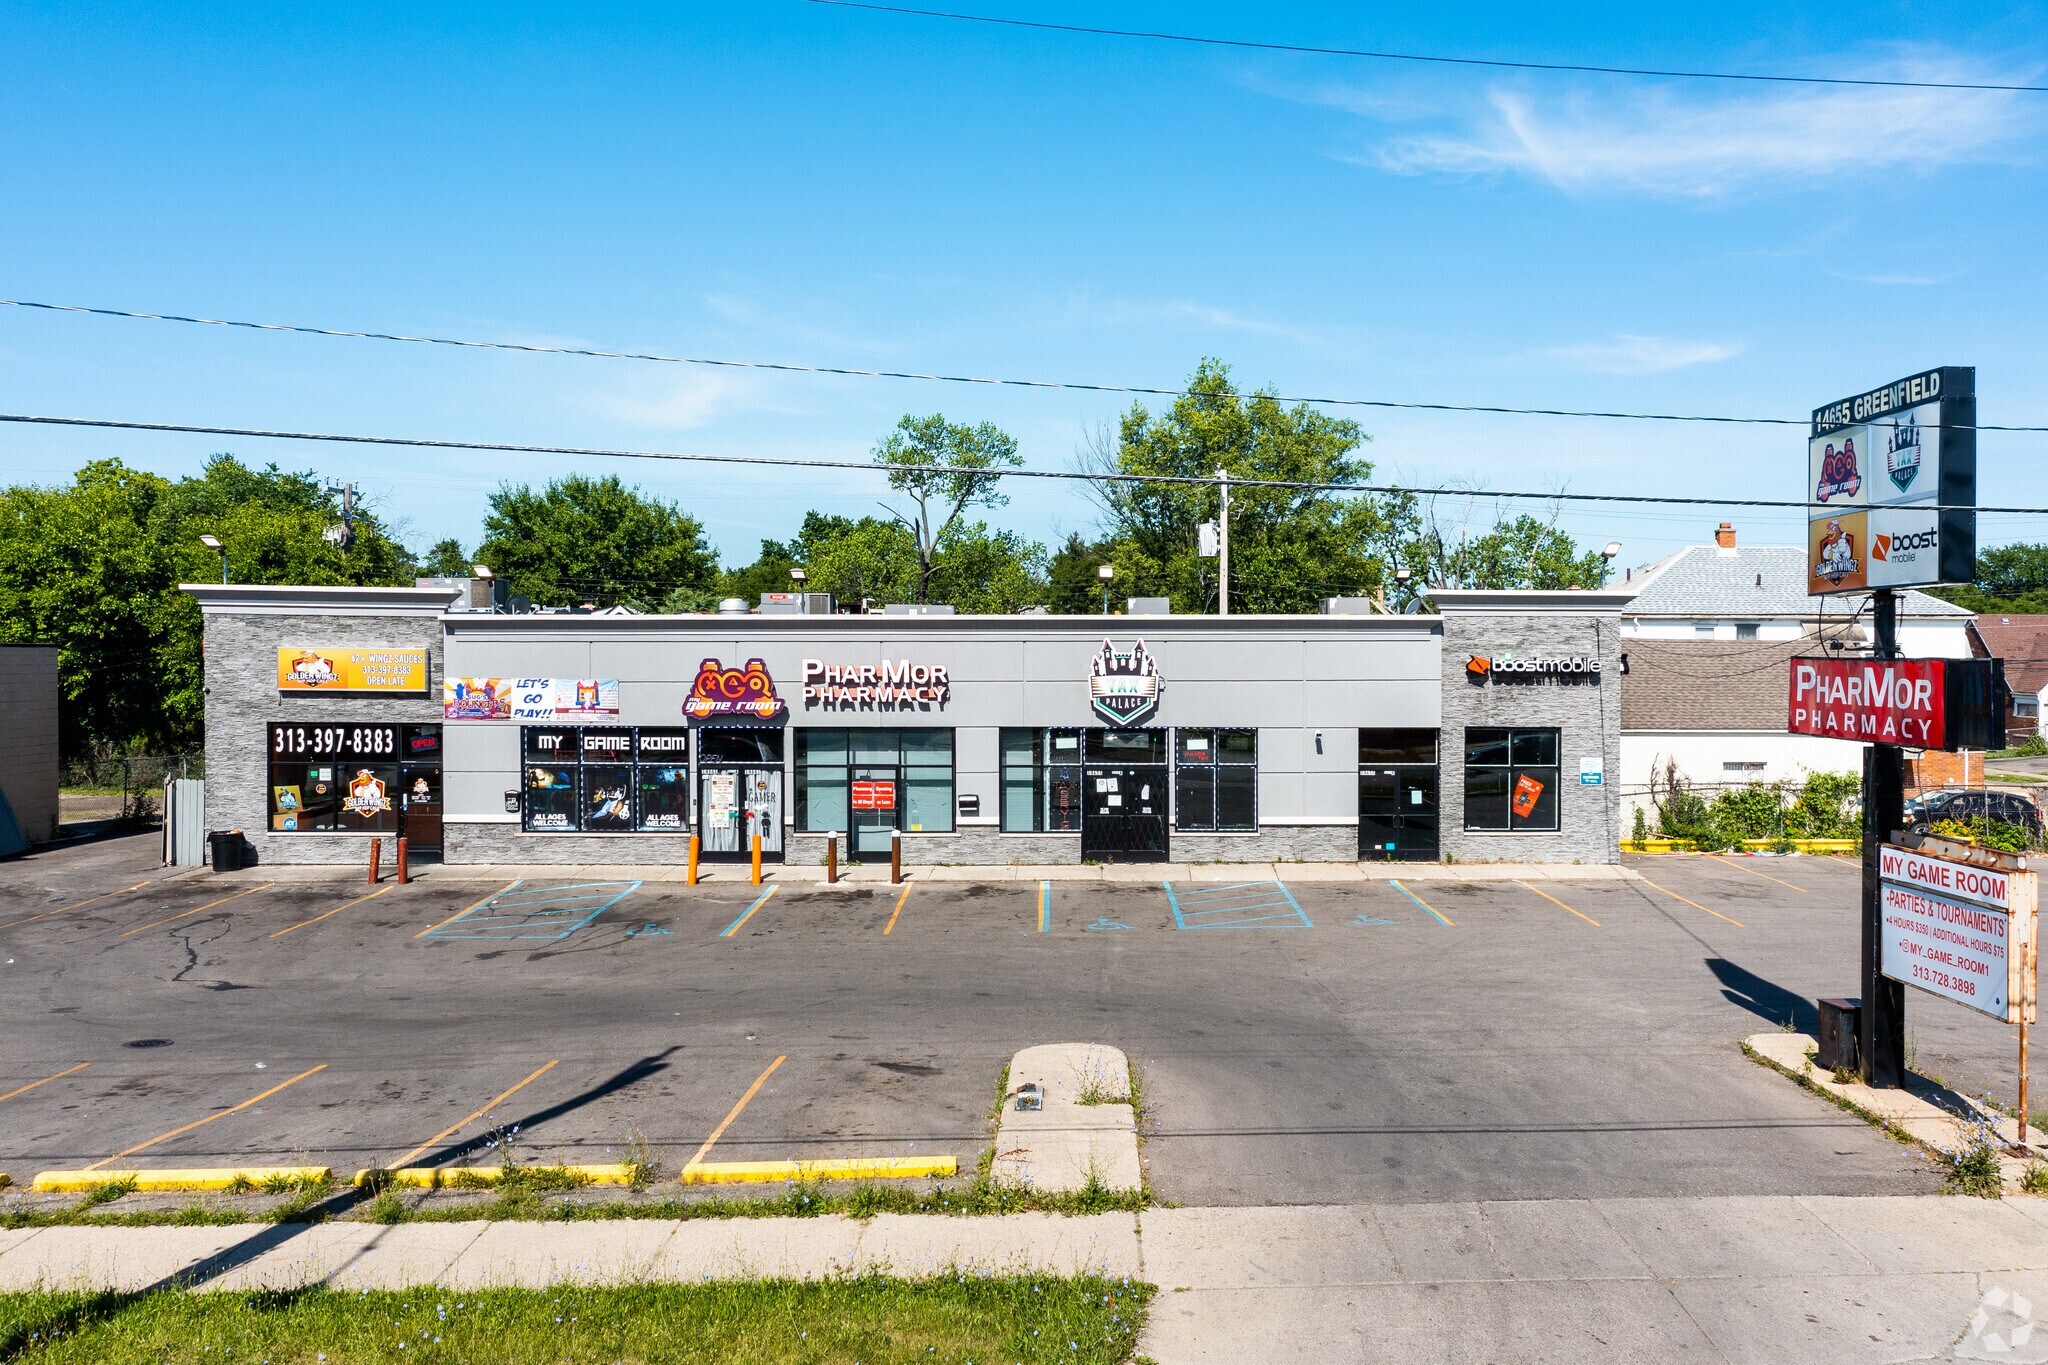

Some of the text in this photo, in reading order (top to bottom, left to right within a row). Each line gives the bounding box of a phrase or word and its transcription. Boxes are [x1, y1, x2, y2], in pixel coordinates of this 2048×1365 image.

[1816, 372, 1940, 432] 14655 GREENFIELD
[1896, 450, 1912, 467] TAX
[1895, 468, 1913, 480] PALACE
[1818, 479, 1860, 498] game room
[1892, 526, 1937, 552] boost
[1892, 552, 1916, 564] mobile
[1815, 558, 1858, 577] GOLDEN WINGZ
[368, 654, 392, 663] WINGZ
[394, 654, 423, 663] SAUCES
[362, 665, 411, 674] 313-397-8383
[287, 672, 338, 681] GOLDEN WINGZ
[366, 676, 405, 685] OPEN LATE
[516, 679, 549, 689] LET'S
[1109, 678, 1139, 693] TAX
[523, 694, 543, 704] GO
[802, 686, 947, 703] PHARMACY
[685, 701, 782, 713] game room
[1106, 698, 1141, 708] PALACE
[513, 708, 554, 719] PLAY!!
[1795, 708, 1932, 740] PHARMACY
[275, 728, 393, 753] 313-397-8383
[411, 737, 435, 749] OPEN
[538, 735, 685, 750] MY GAME ROOM
[1053, 781, 1075, 790] TAX
[348, 797, 386, 807] GOLDEN WINGZ
[748, 792, 776, 803] GAMER
[1883, 855, 2006, 900] MY GAME ROOM
[1928, 900, 1934, 917] &
[1936, 902, 2004, 937] TOURNAMENTS
[1894, 917, 1914, 931] HOURS
[1933, 928, 1969, 948] ADDITIONAL
[1970, 938, 1992, 955] HOURS
[1912, 964, 1976, 996] 313.728.3898
